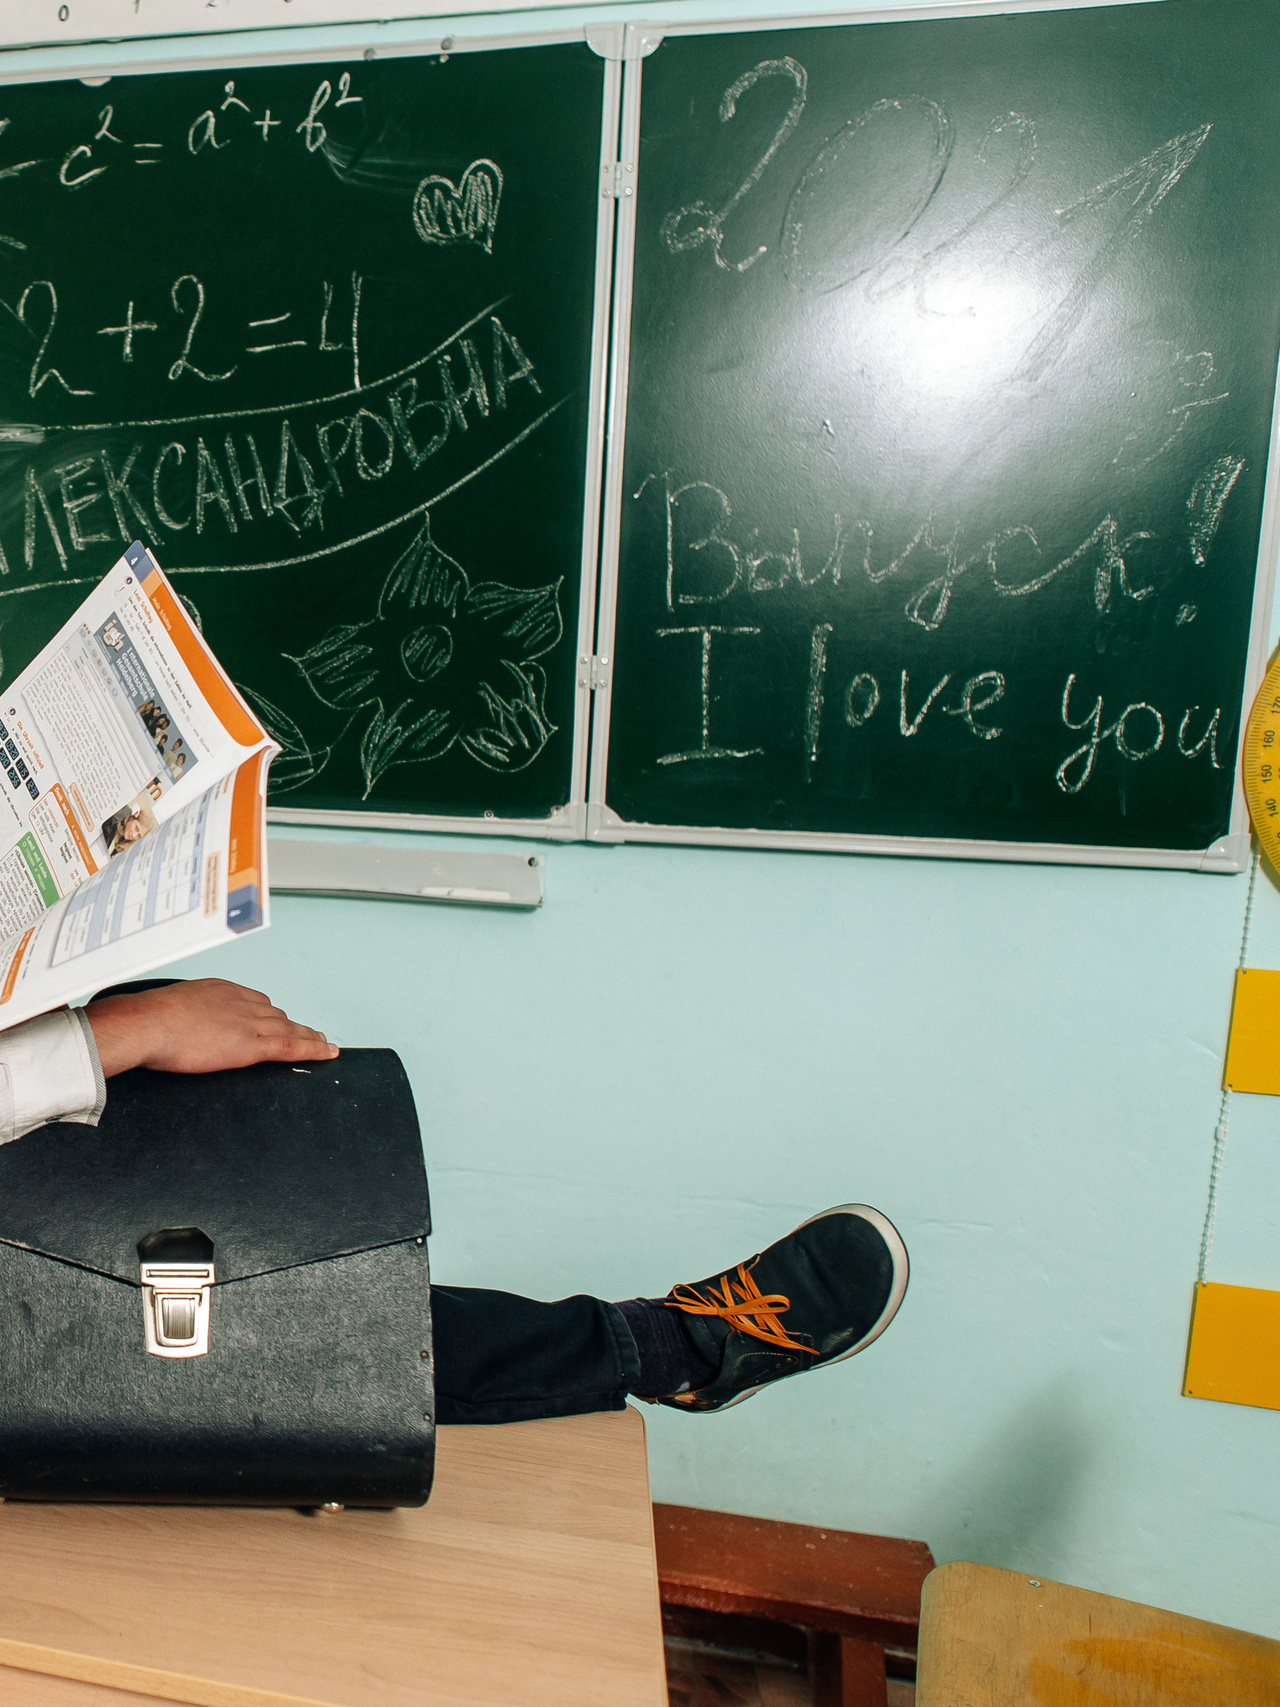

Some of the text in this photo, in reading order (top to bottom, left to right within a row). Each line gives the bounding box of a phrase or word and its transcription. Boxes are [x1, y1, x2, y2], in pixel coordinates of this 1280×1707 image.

[57, 4, 70, 22] 0
[129, 556, 138, 566] 4
[138, 600, 153, 624] Schultag
[157, 608, 172, 631] Schultag
[115, 657, 137, 698] Heidelberg
[121, 651, 148, 701] Gesamtschule
[127, 646, 155, 699] Internationale
[656, 623, 1223, 793] I love you
[22, 730, 33, 750] Uhrzeit
[32, 749, 44, 770] offiziell
[1263, 730, 1276, 749] 160
[1261, 764, 1273, 783] 150
[54, 786, 69, 816] Denk nach
[1265, 798, 1277, 817] 140
[26, 835, 34, 851] Land
[38, 862, 47, 879] Leute
